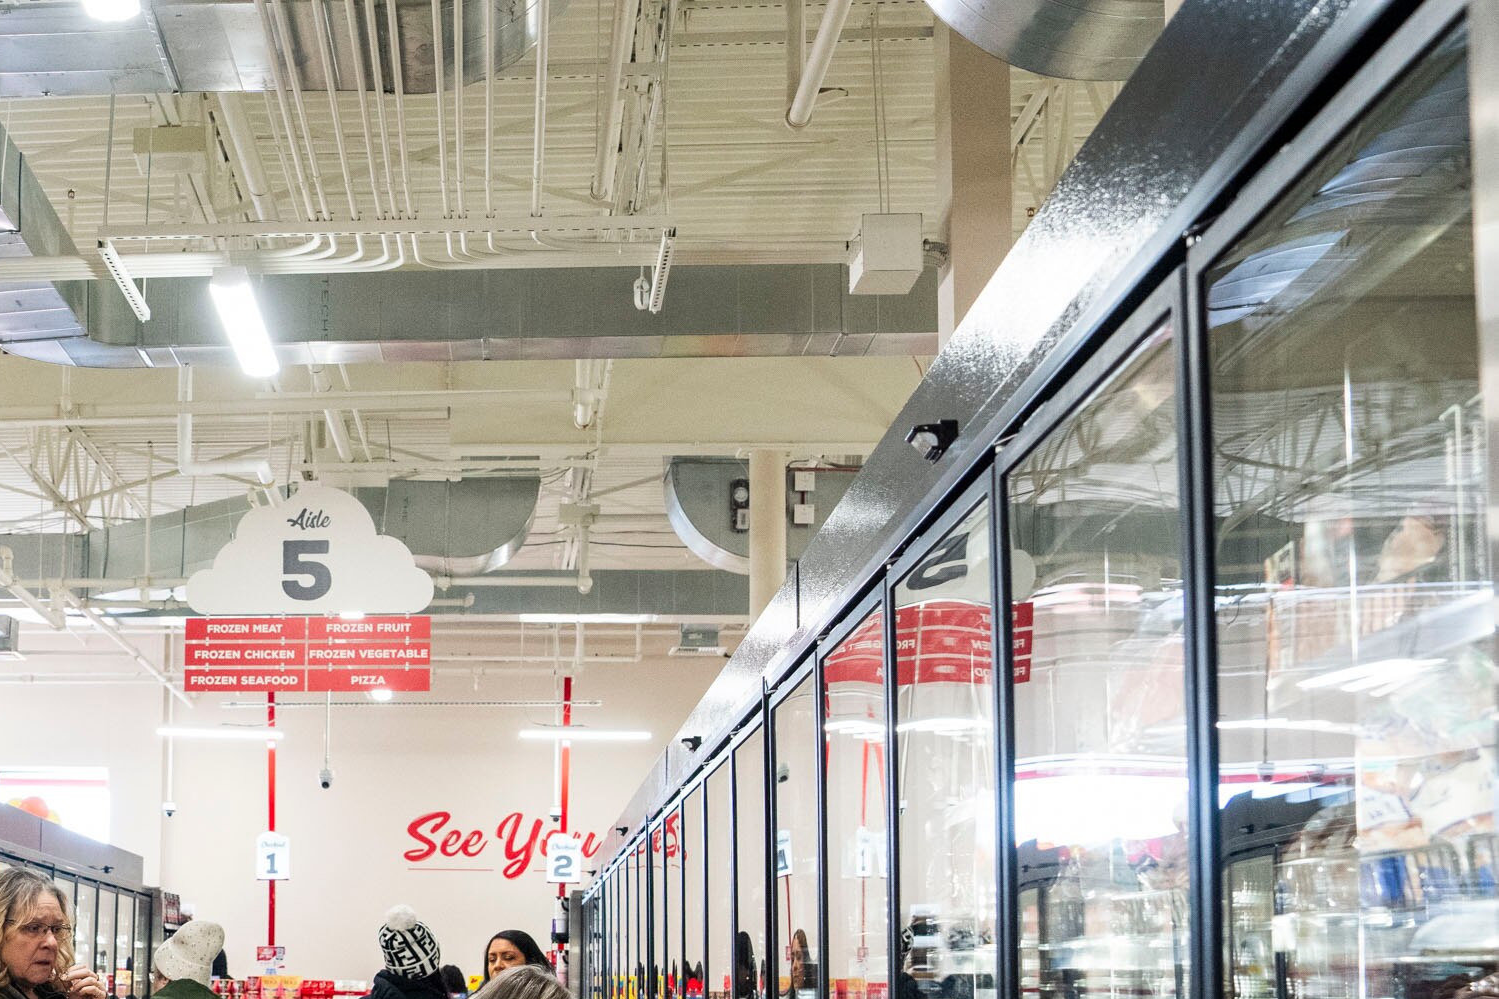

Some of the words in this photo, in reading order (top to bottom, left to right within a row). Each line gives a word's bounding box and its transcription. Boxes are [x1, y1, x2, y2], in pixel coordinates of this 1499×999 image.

[287, 508, 331, 530] Aisle
[282, 540, 332, 601] 5
[207, 624, 249, 633] FROZEN
[253, 623, 283, 633] MEAT
[326, 623, 373, 633] FROZEN
[377, 623, 411, 632] FRUIT
[194, 650, 241, 659] FROZEN
[244, 649, 295, 659] CHICKEN
[309, 649, 356, 659] FROZEN
[359, 649, 428, 658] VEGETABLE
[190, 676, 237, 685] FROZEN
[241, 675, 298, 685] SEAFOOD
[351, 676, 385, 685] PIZZA
[403, 811, 489, 862] See
[266, 853, 278, 874] 1
[553, 855, 573, 877] 2
